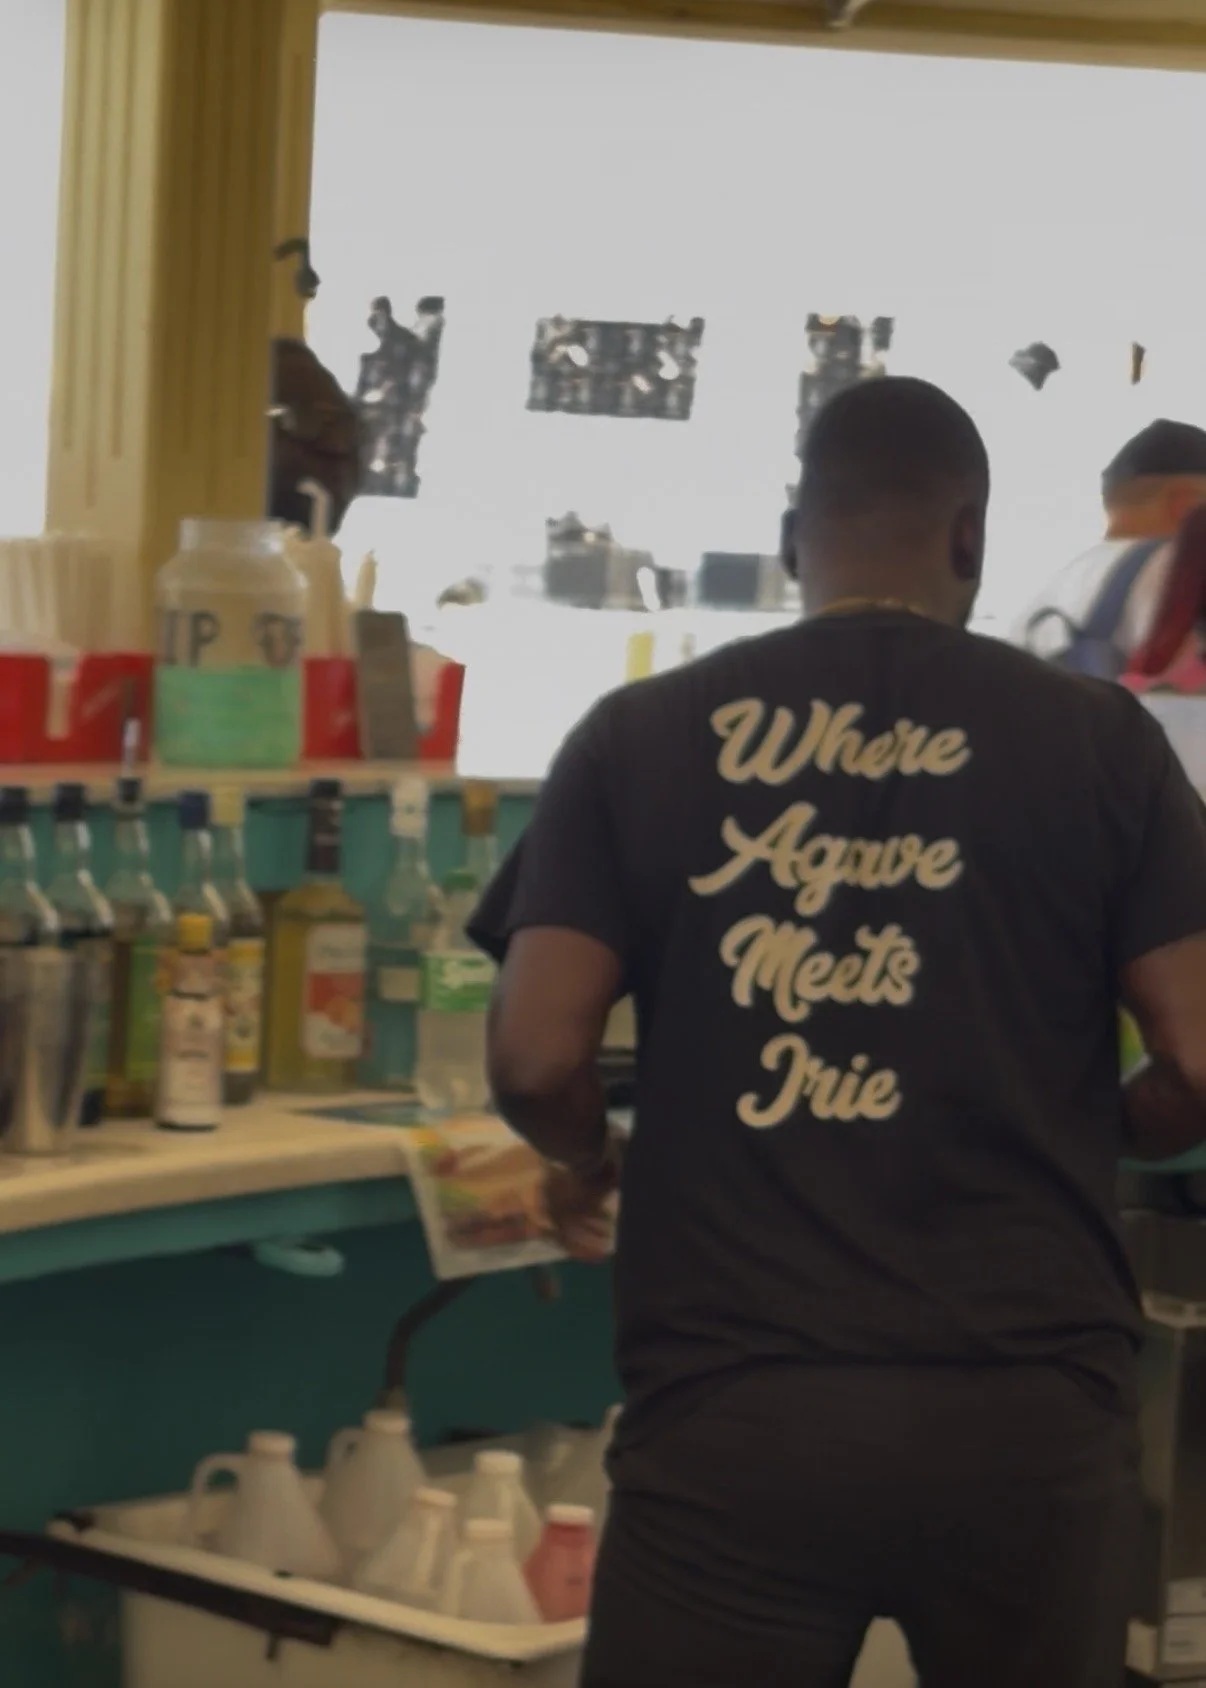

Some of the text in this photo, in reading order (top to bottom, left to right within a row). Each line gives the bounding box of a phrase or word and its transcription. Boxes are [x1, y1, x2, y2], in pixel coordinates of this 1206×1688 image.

[711, 699, 972, 785] Where
[689, 803, 962, 916] Agave
[720, 916, 919, 1022] Meets
[736, 1035, 900, 1128] Irie
